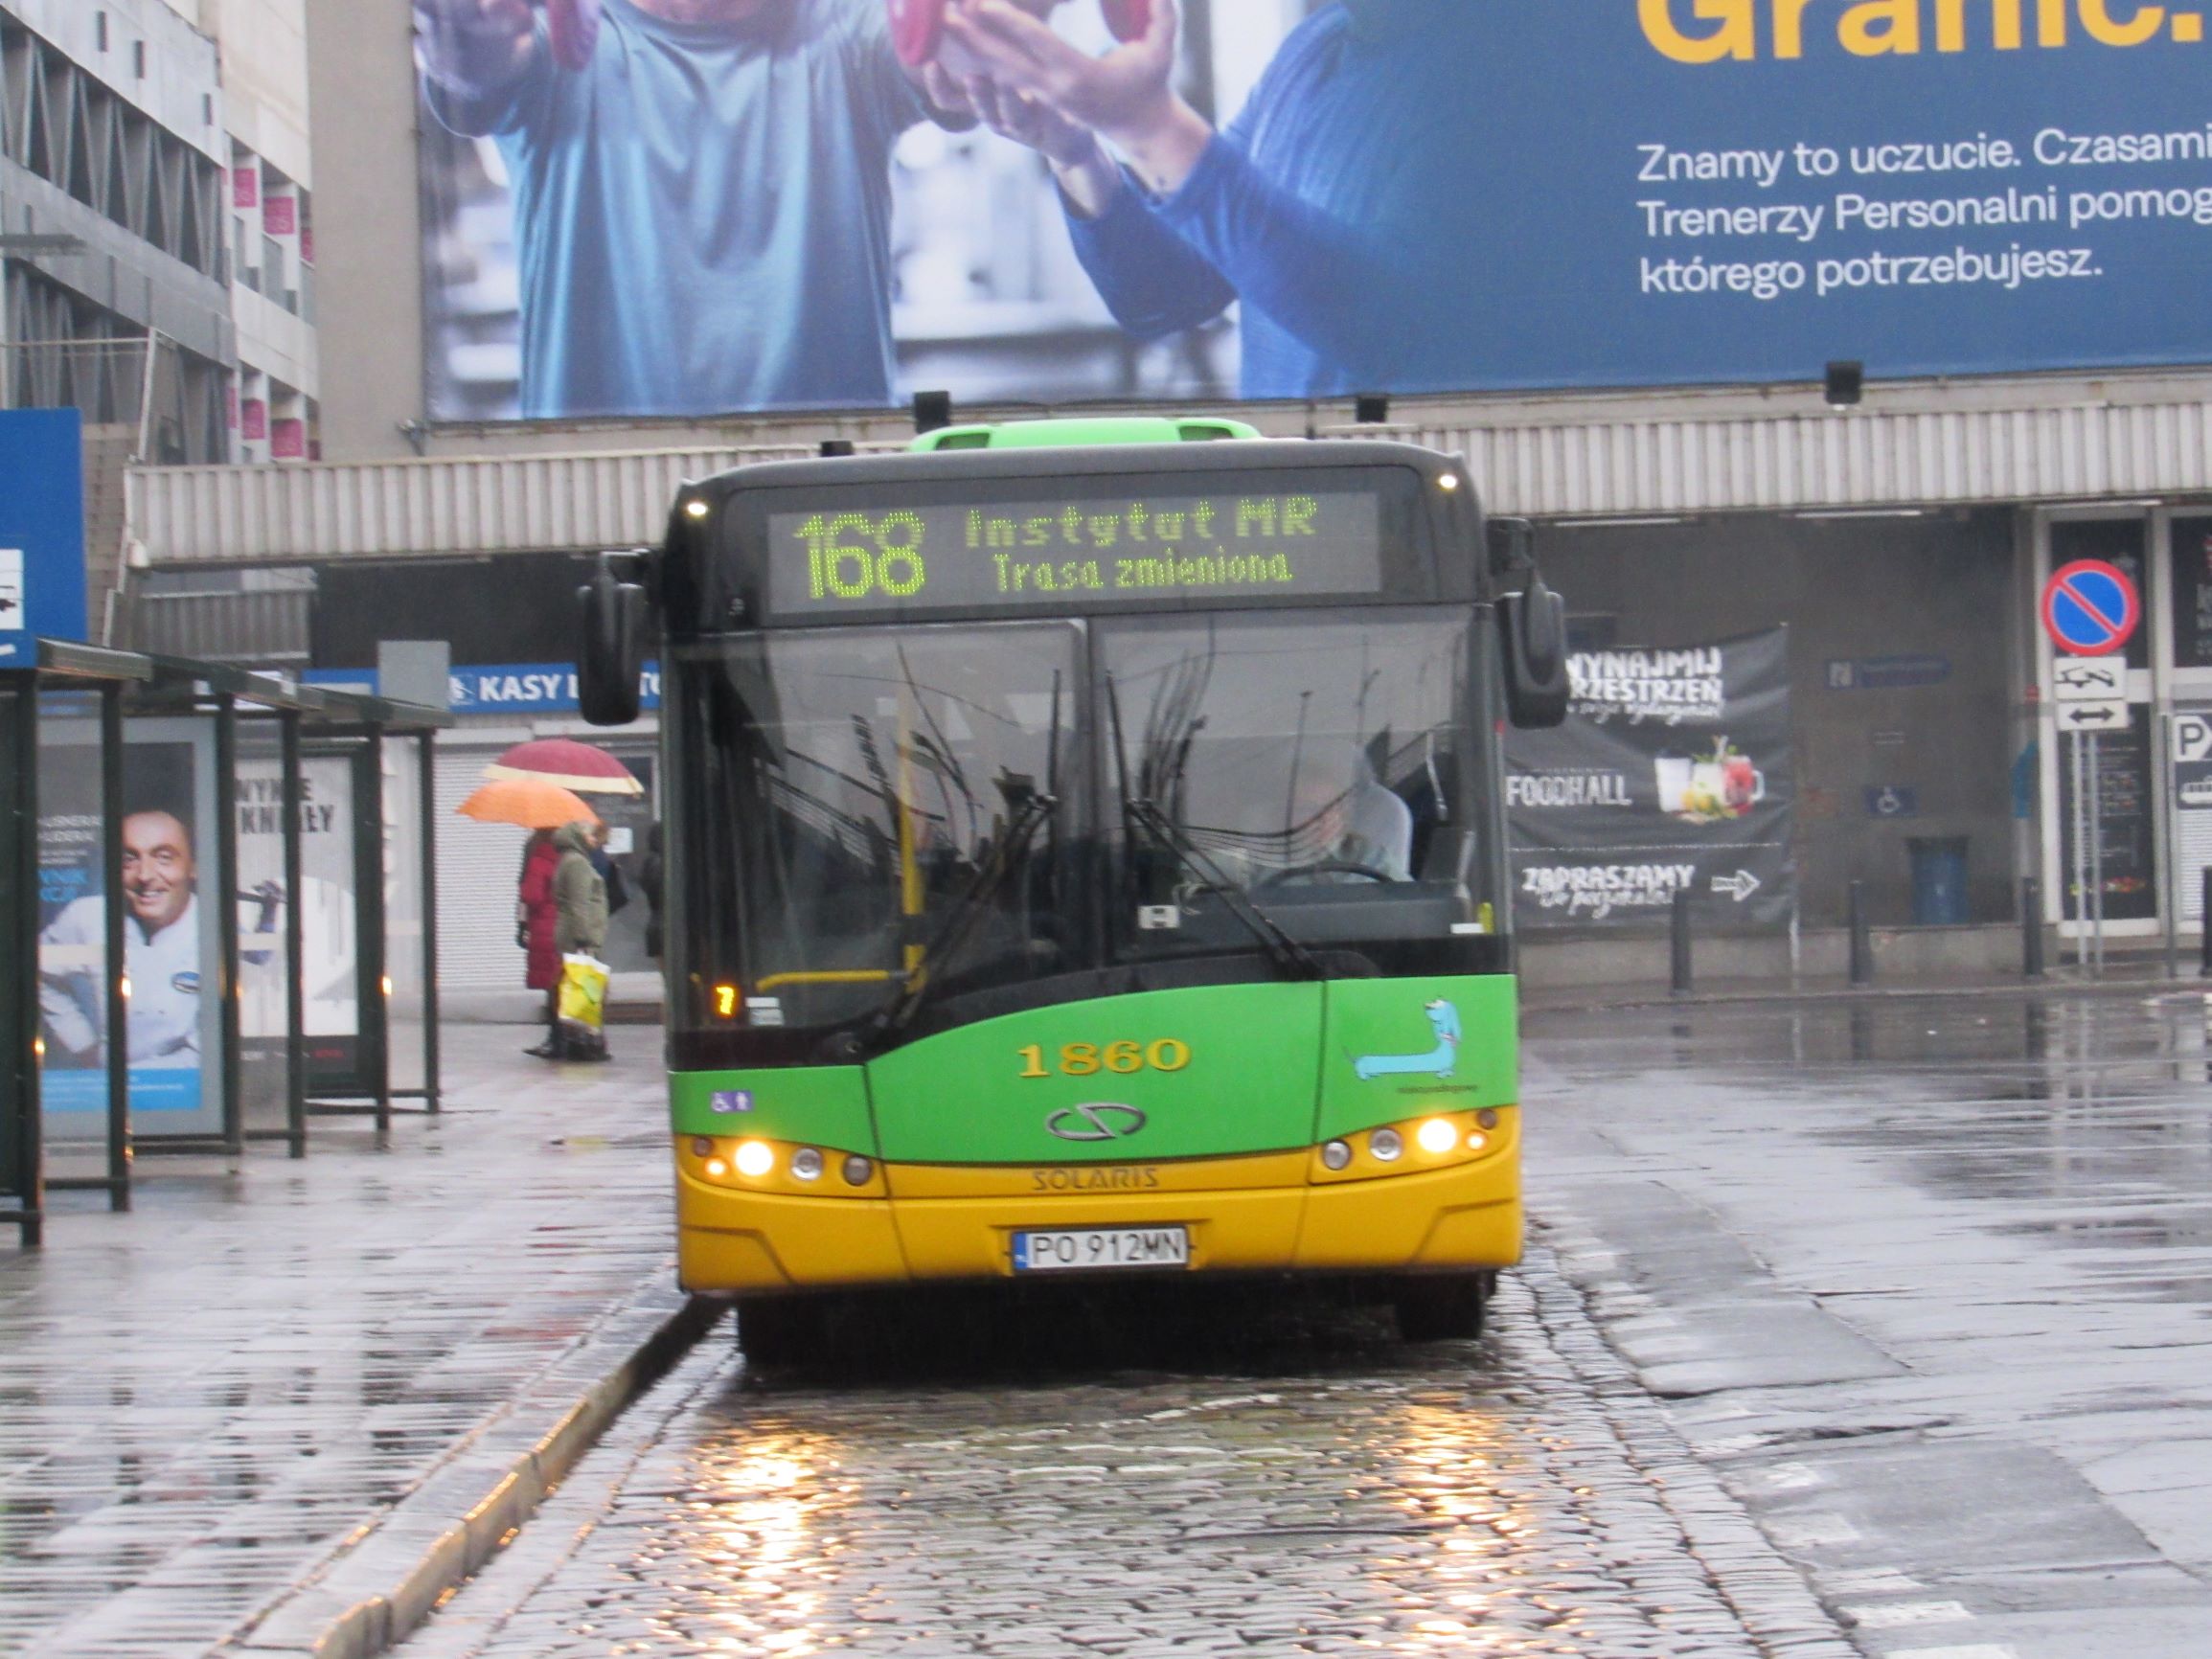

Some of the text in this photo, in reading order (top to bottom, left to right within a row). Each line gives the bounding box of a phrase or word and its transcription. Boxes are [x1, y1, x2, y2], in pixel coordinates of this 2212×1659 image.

[1637, 123, 2212, 187] Znamy to uczucie. Czasami
[1637, 199, 1823, 241] Trenerzy
[1836, 186, 2057, 231] Personalni
[1640, 243, 2102, 299] którego potrzebujesz.
[967, 497, 1317, 547] Instytut MR
[793, 510, 926, 599] 168
[992, 545, 1292, 592] Trasa zmieniona
[479, 674, 562, 701] KASY
[1567, 675, 1723, 703] RZESTRZEŃ
[2178, 722, 2204, 756] P
[1506, 775, 1632, 806] FOODHALL
[1018, 1037, 1191, 1078] 1860
[1033, 1166, 1160, 1192] SOLARIS
[1033, 1235, 1077, 1264] PO
